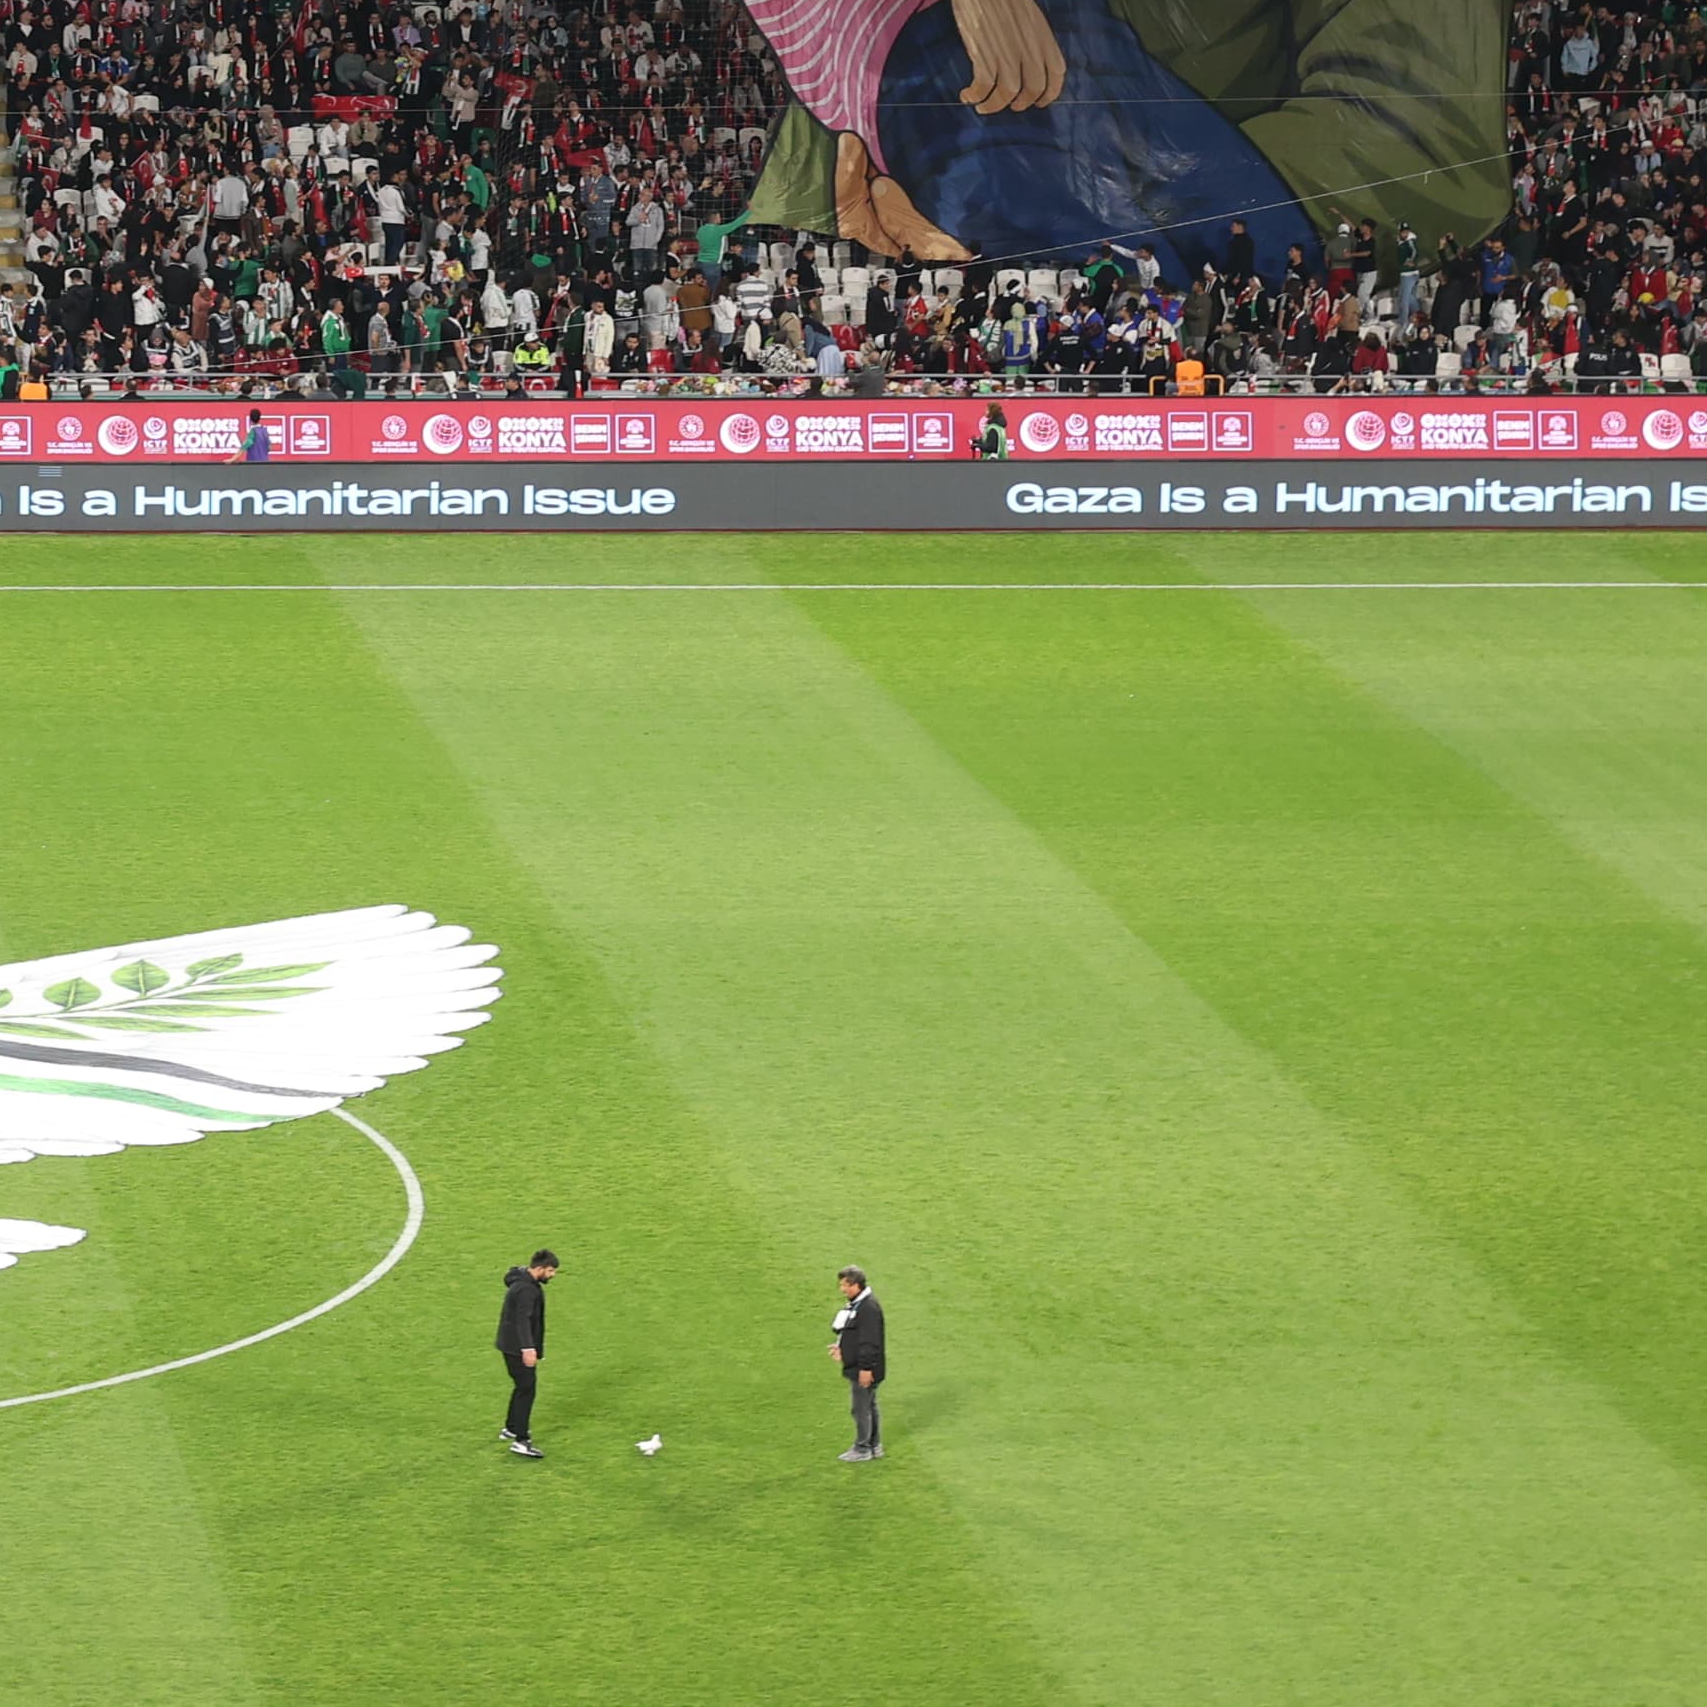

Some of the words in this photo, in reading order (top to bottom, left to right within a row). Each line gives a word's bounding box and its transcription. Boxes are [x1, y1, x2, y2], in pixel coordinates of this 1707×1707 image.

[174, 432, 242, 448] KONYA
[498, 431, 566, 447] KONYA
[796, 430, 864, 446] KONYA
[1095, 429, 1163, 445] KONYA
[1421, 427, 1489, 443] KONYA
[19, 485, 65, 516] Is
[81, 489, 117, 516] a
[134, 480, 509, 516] Humanitarian
[523, 484, 676, 515] Issue
[1006, 482, 1142, 513] Gaza
[1159, 482, 1206, 513] Is
[1222, 486, 1258, 513] a
[1276, 478, 1652, 513] Humanitarian
